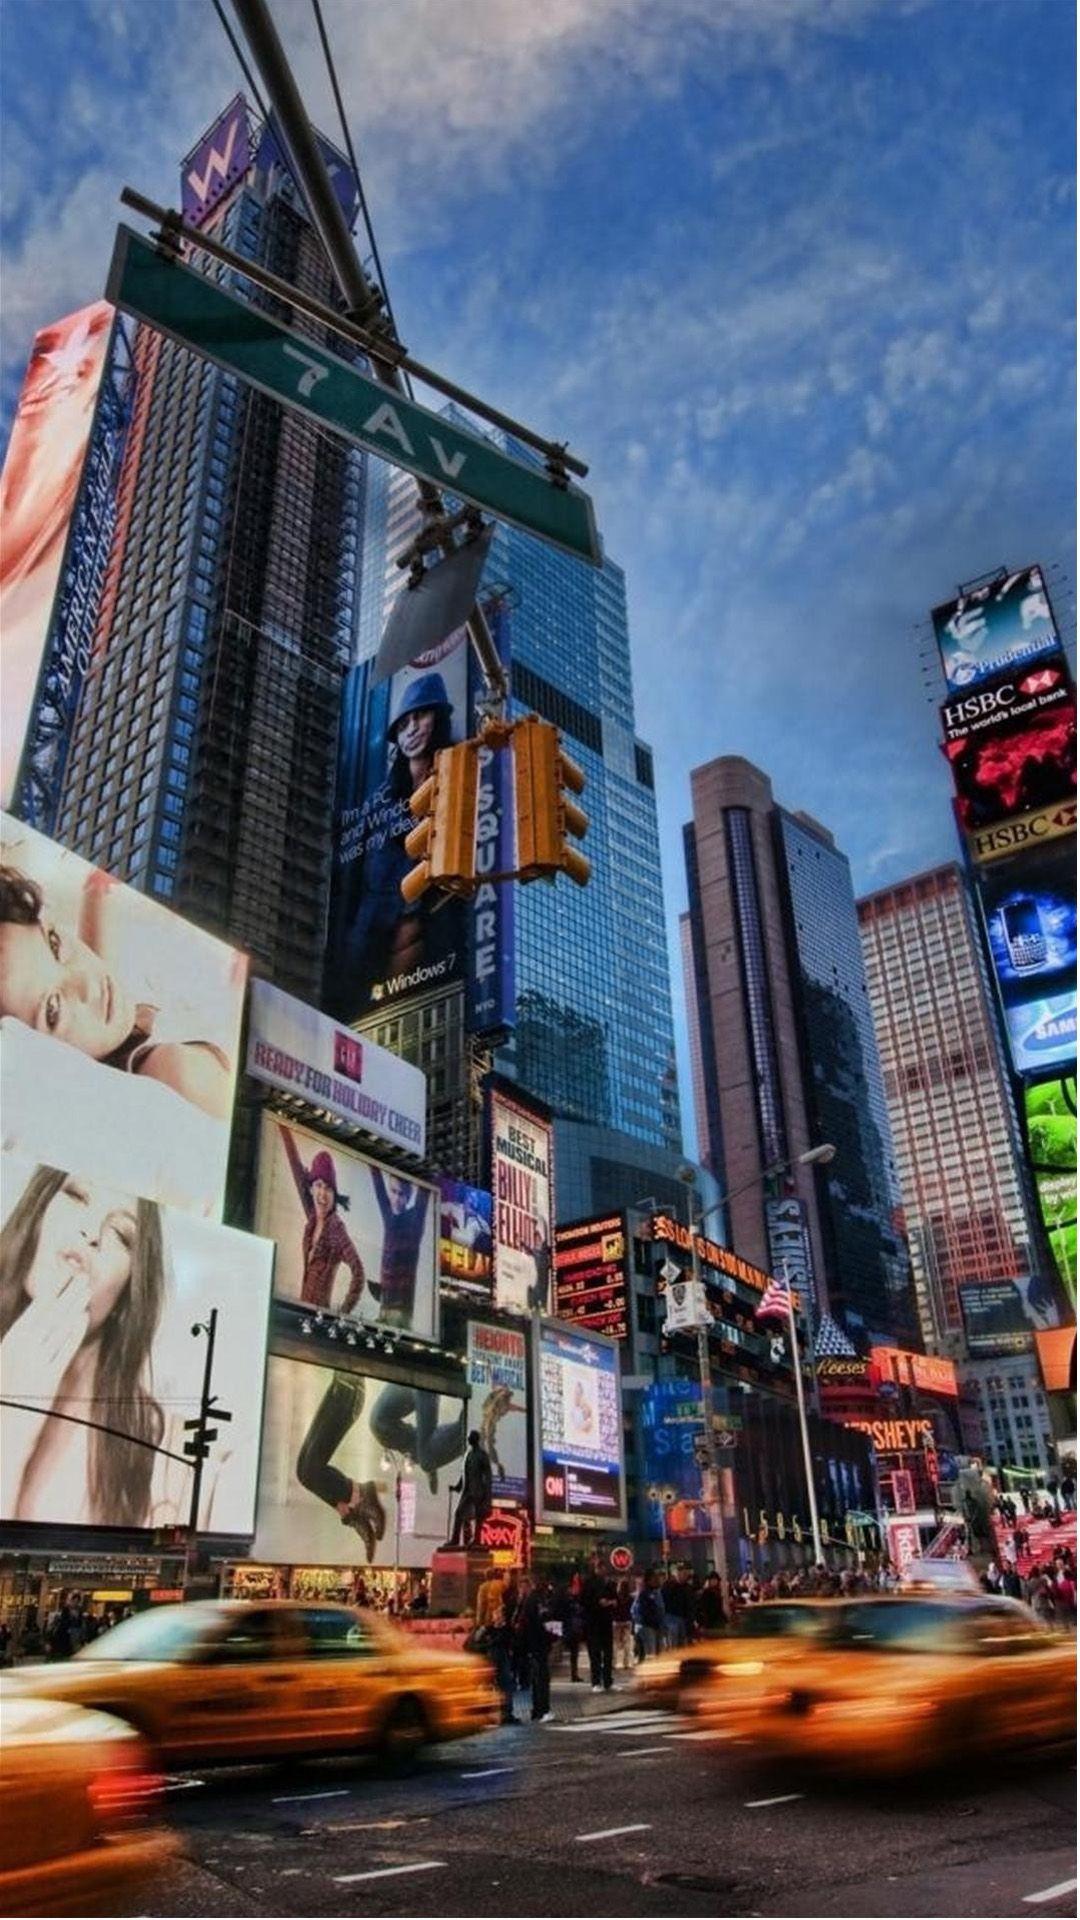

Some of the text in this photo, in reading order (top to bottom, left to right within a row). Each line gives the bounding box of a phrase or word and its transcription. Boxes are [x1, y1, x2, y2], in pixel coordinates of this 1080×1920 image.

[187, 119, 239, 203] W
[282, 343, 330, 398] 7
[59, 530, 98, 701] AMERICAN
[979, 631, 1057, 674] Prudential
[944, 684, 1016, 728] HSBC
[947, 687, 1068, 740] The world's local bank
[366, 798, 410, 830] Windo
[975, 814, 1050, 854] HSBC
[474, 783, 500, 979] SQUARE
[386, 952, 457, 995] Windows 7
[255, 1041, 421, 1145] READY FOR HOLIDAY CHEER
[496, 1135, 548, 1179] MUSICAL
[508, 1125, 536, 1153] BEST
[498, 1158, 533, 1214] BILLY
[844, 1420, 934, 1451] SHEY'S
[480, 1523, 514, 1546] ROXY
